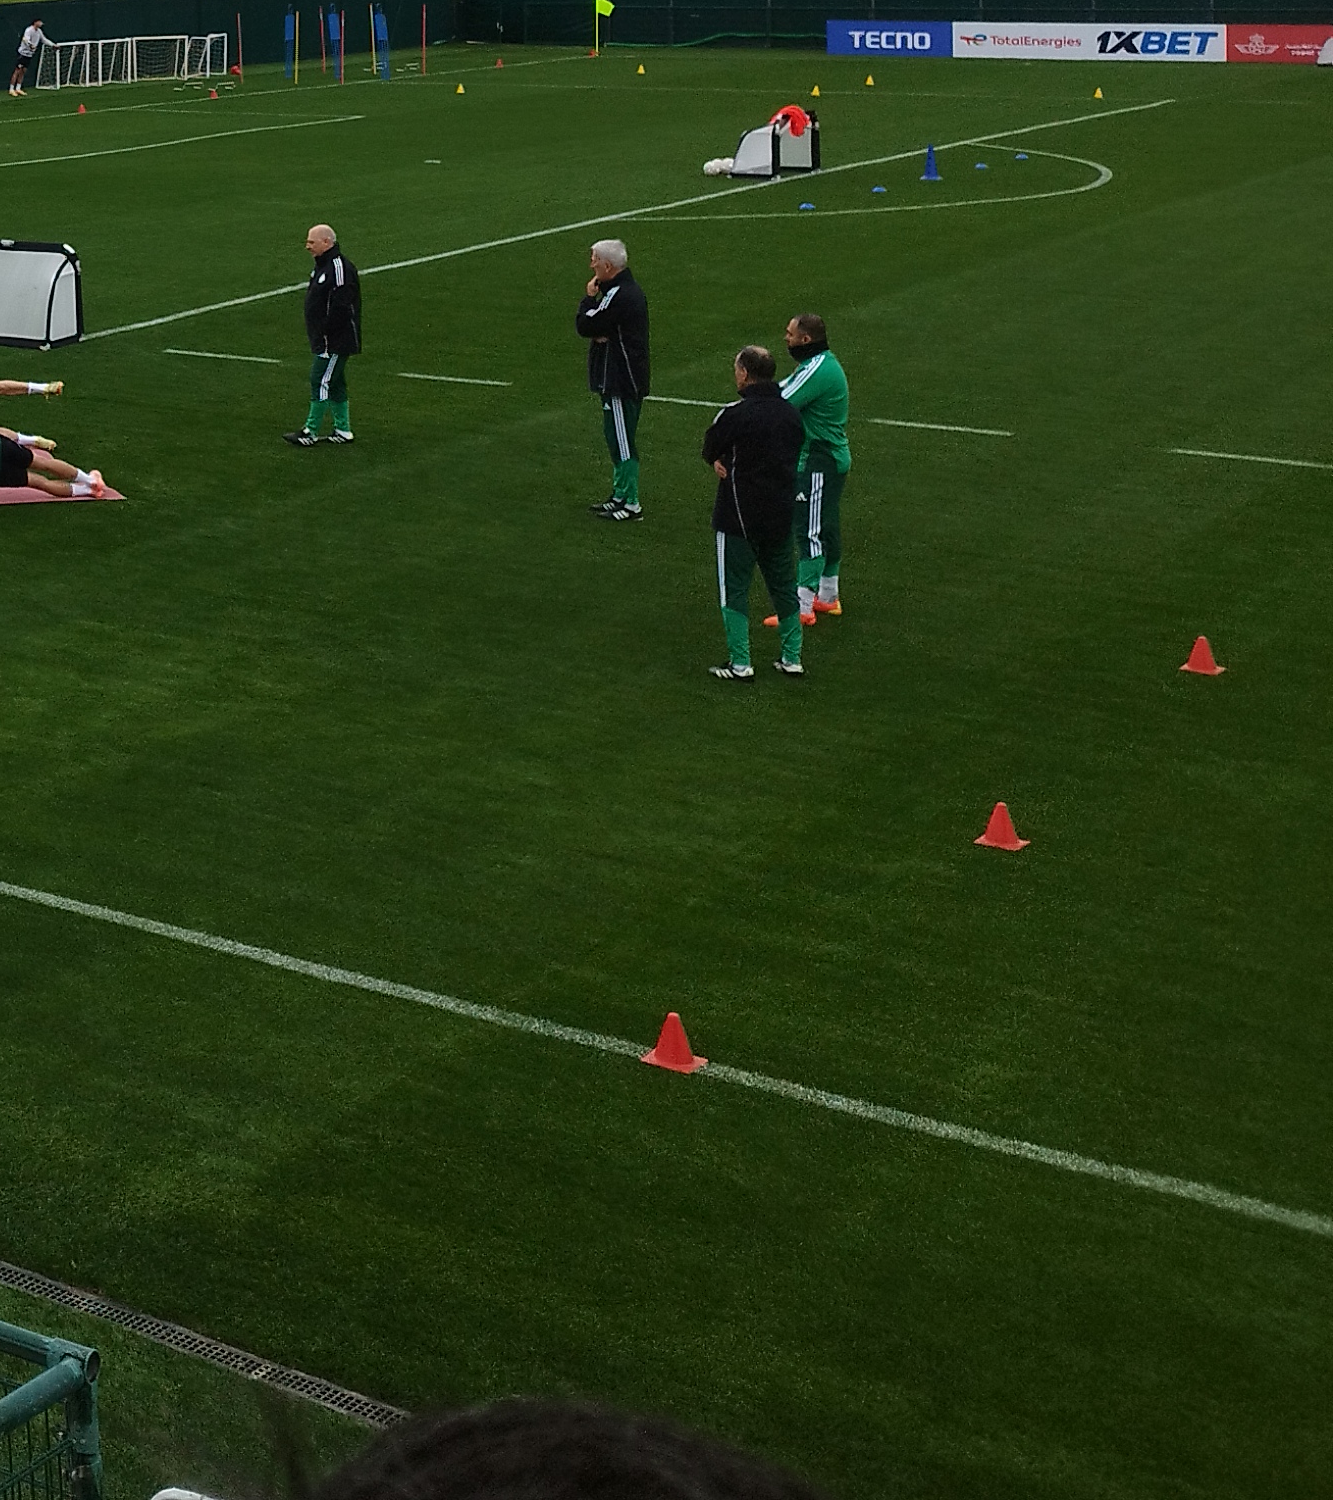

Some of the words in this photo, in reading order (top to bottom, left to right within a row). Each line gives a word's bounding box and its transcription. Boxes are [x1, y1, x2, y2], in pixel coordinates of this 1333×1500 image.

[848, 31, 931, 50] TECNO
[990, 36, 1082, 49] TotalEnergies
[1096, 31, 1219, 56] 1XBET
